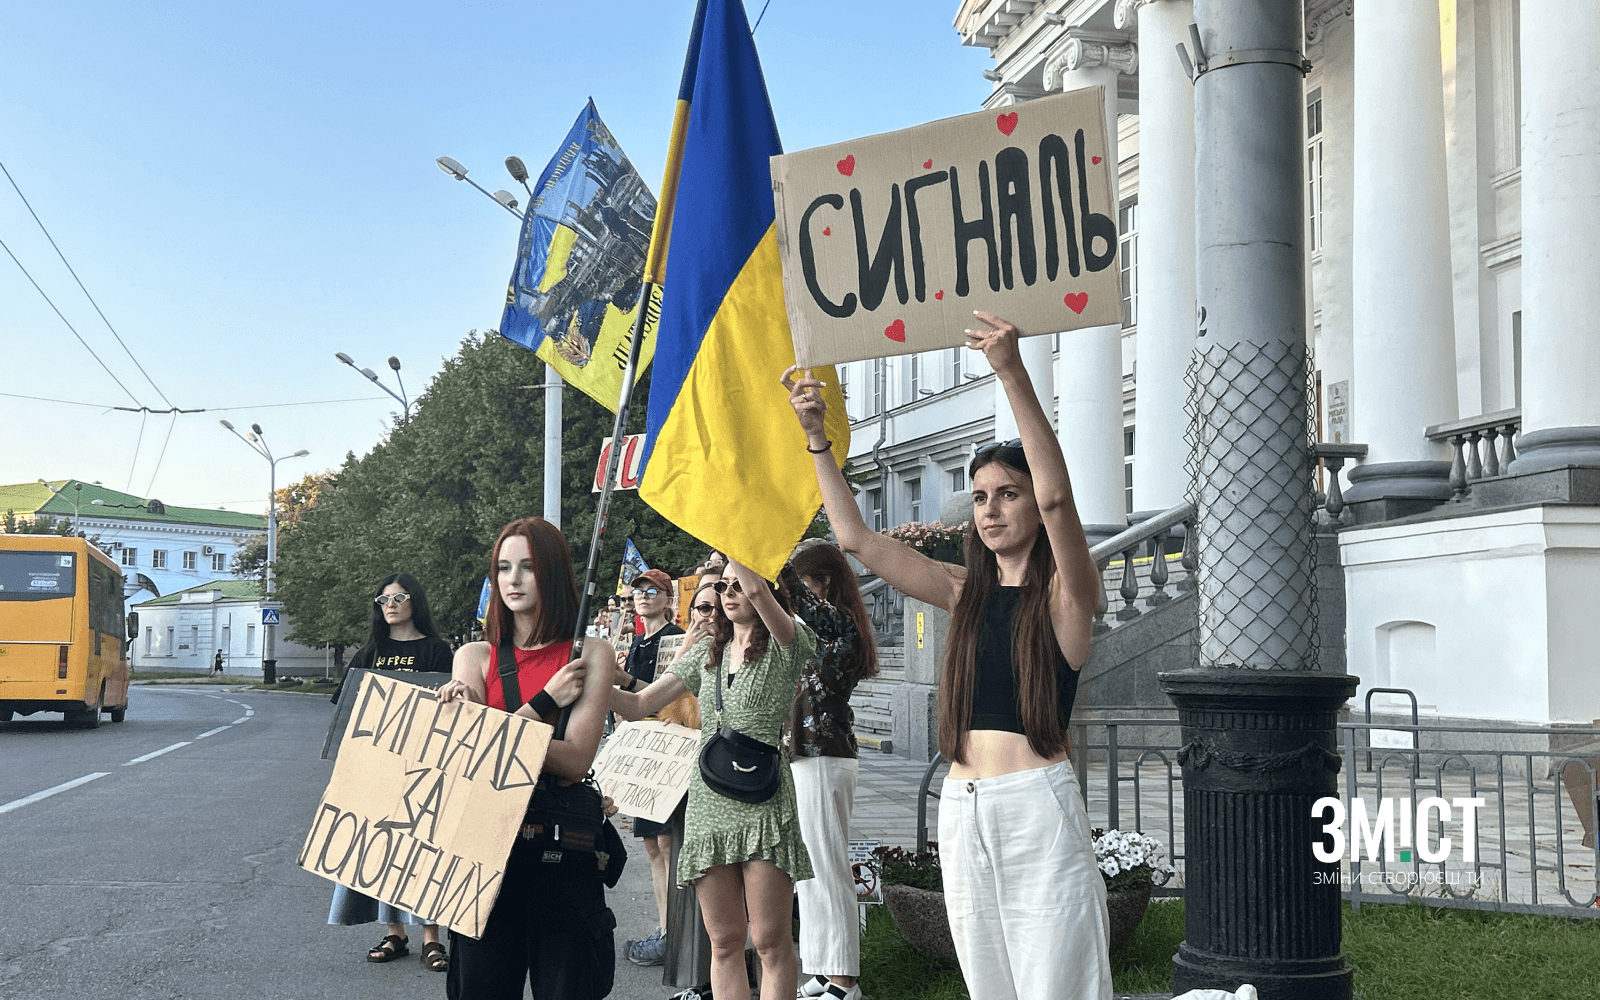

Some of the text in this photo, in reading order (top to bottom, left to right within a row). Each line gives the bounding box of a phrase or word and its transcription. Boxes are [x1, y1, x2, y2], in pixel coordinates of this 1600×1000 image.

[799, 128, 1117, 319] СИГНАЛЬ
[387, 655, 415, 666] FREE
[351, 674, 535, 791] СИГНАЛЬ
[635, 757, 664, 781] ТАМ
[373, 760, 447, 844] ЗА
[297, 802, 502, 939] ПОЛОНЕНИХ
